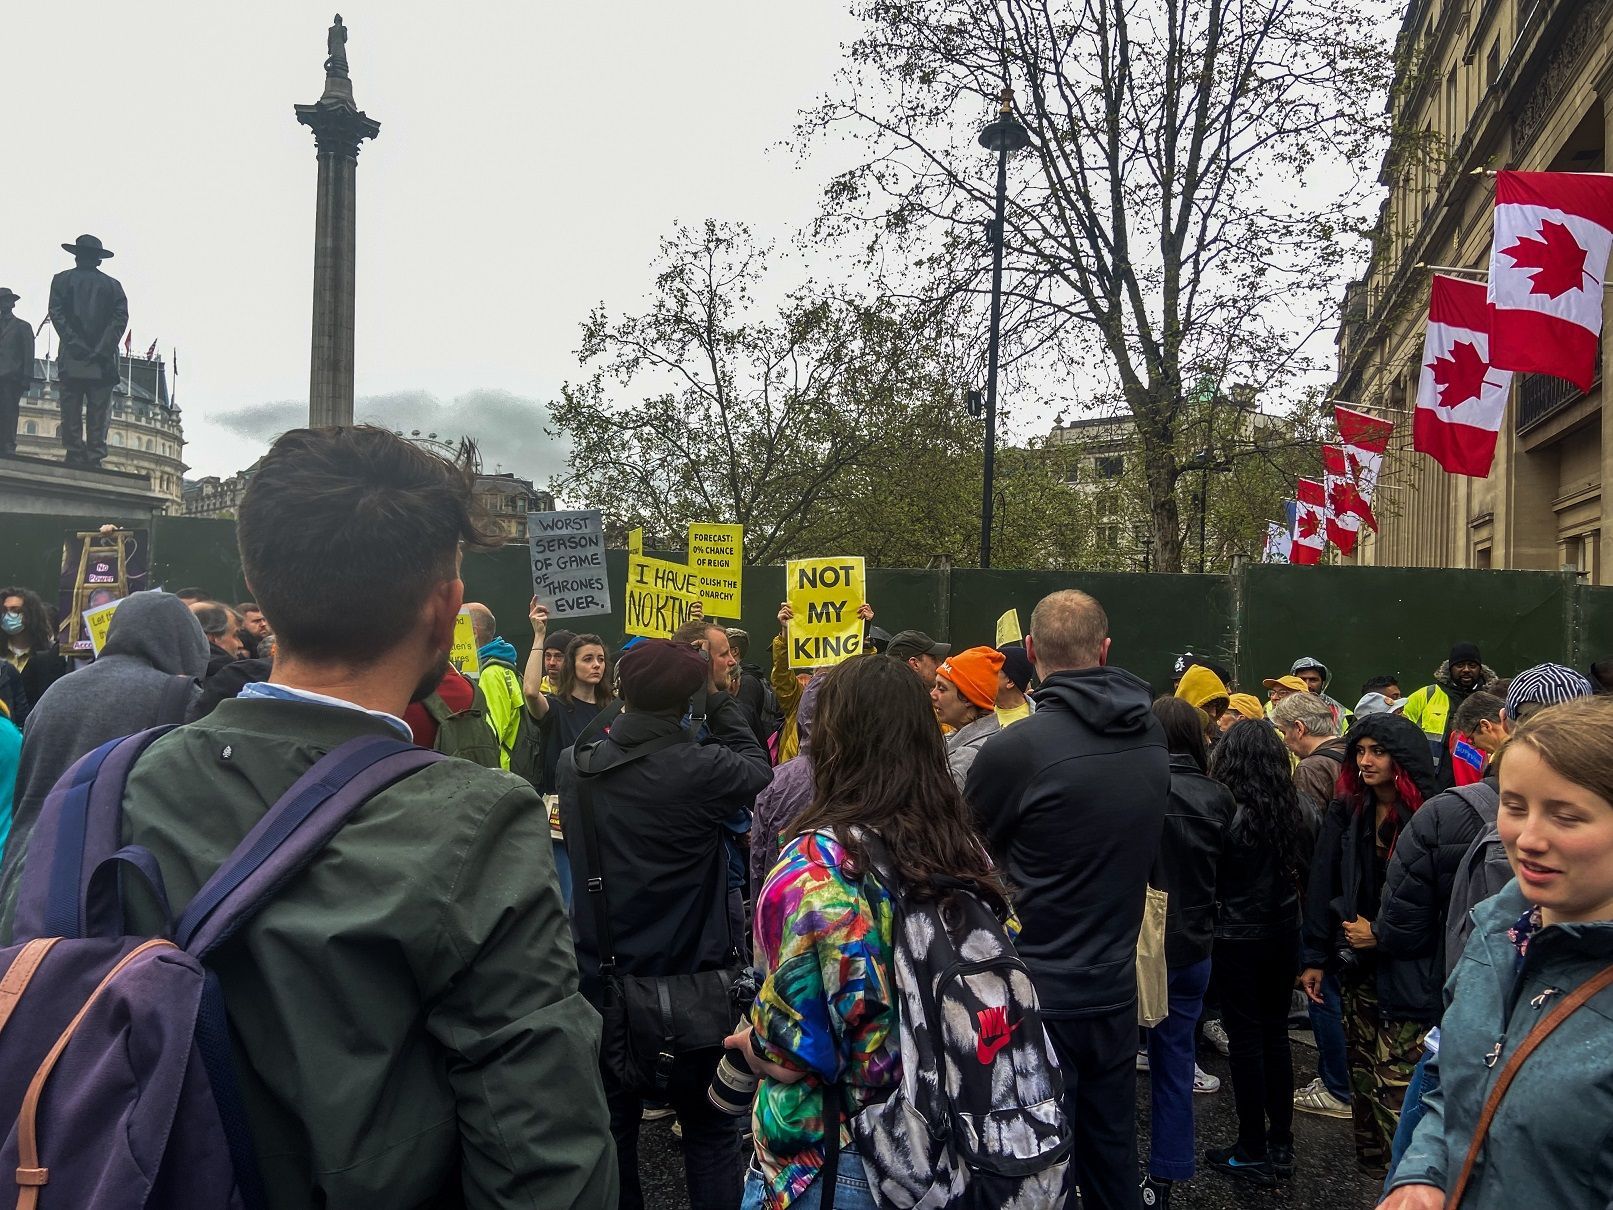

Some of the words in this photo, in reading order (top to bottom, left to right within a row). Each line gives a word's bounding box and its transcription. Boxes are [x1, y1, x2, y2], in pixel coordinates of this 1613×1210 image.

[538, 518, 590, 532] WORST
[536, 534, 599, 554] SEASON
[694, 534, 733, 543] FORECAST:
[692, 545, 704, 554] 0%
[705, 547, 734, 555] CHANCE
[96, 563, 110, 572] No
[535, 557, 553, 572] OF
[556, 552, 601, 570] GAME
[696, 558, 706, 567] OF
[707, 559, 730, 568] REIGN
[88, 574, 114, 583] Power
[535, 573, 549, 586] OF
[543, 577, 604, 596] THRONES
[635, 563, 650, 585] I
[654, 567, 698, 596] HAVE
[700, 577, 722, 587] OLISH
[722, 579, 738, 589] THE
[798, 565, 855, 590] NOT
[554, 594, 604, 613] EVER.
[699, 589, 734, 601] ONARCHY
[628, 590, 654, 628] NO
[807, 599, 848, 625] MY
[794, 633, 860, 660] KING
[976, 1005, 1008, 1040] NIK
